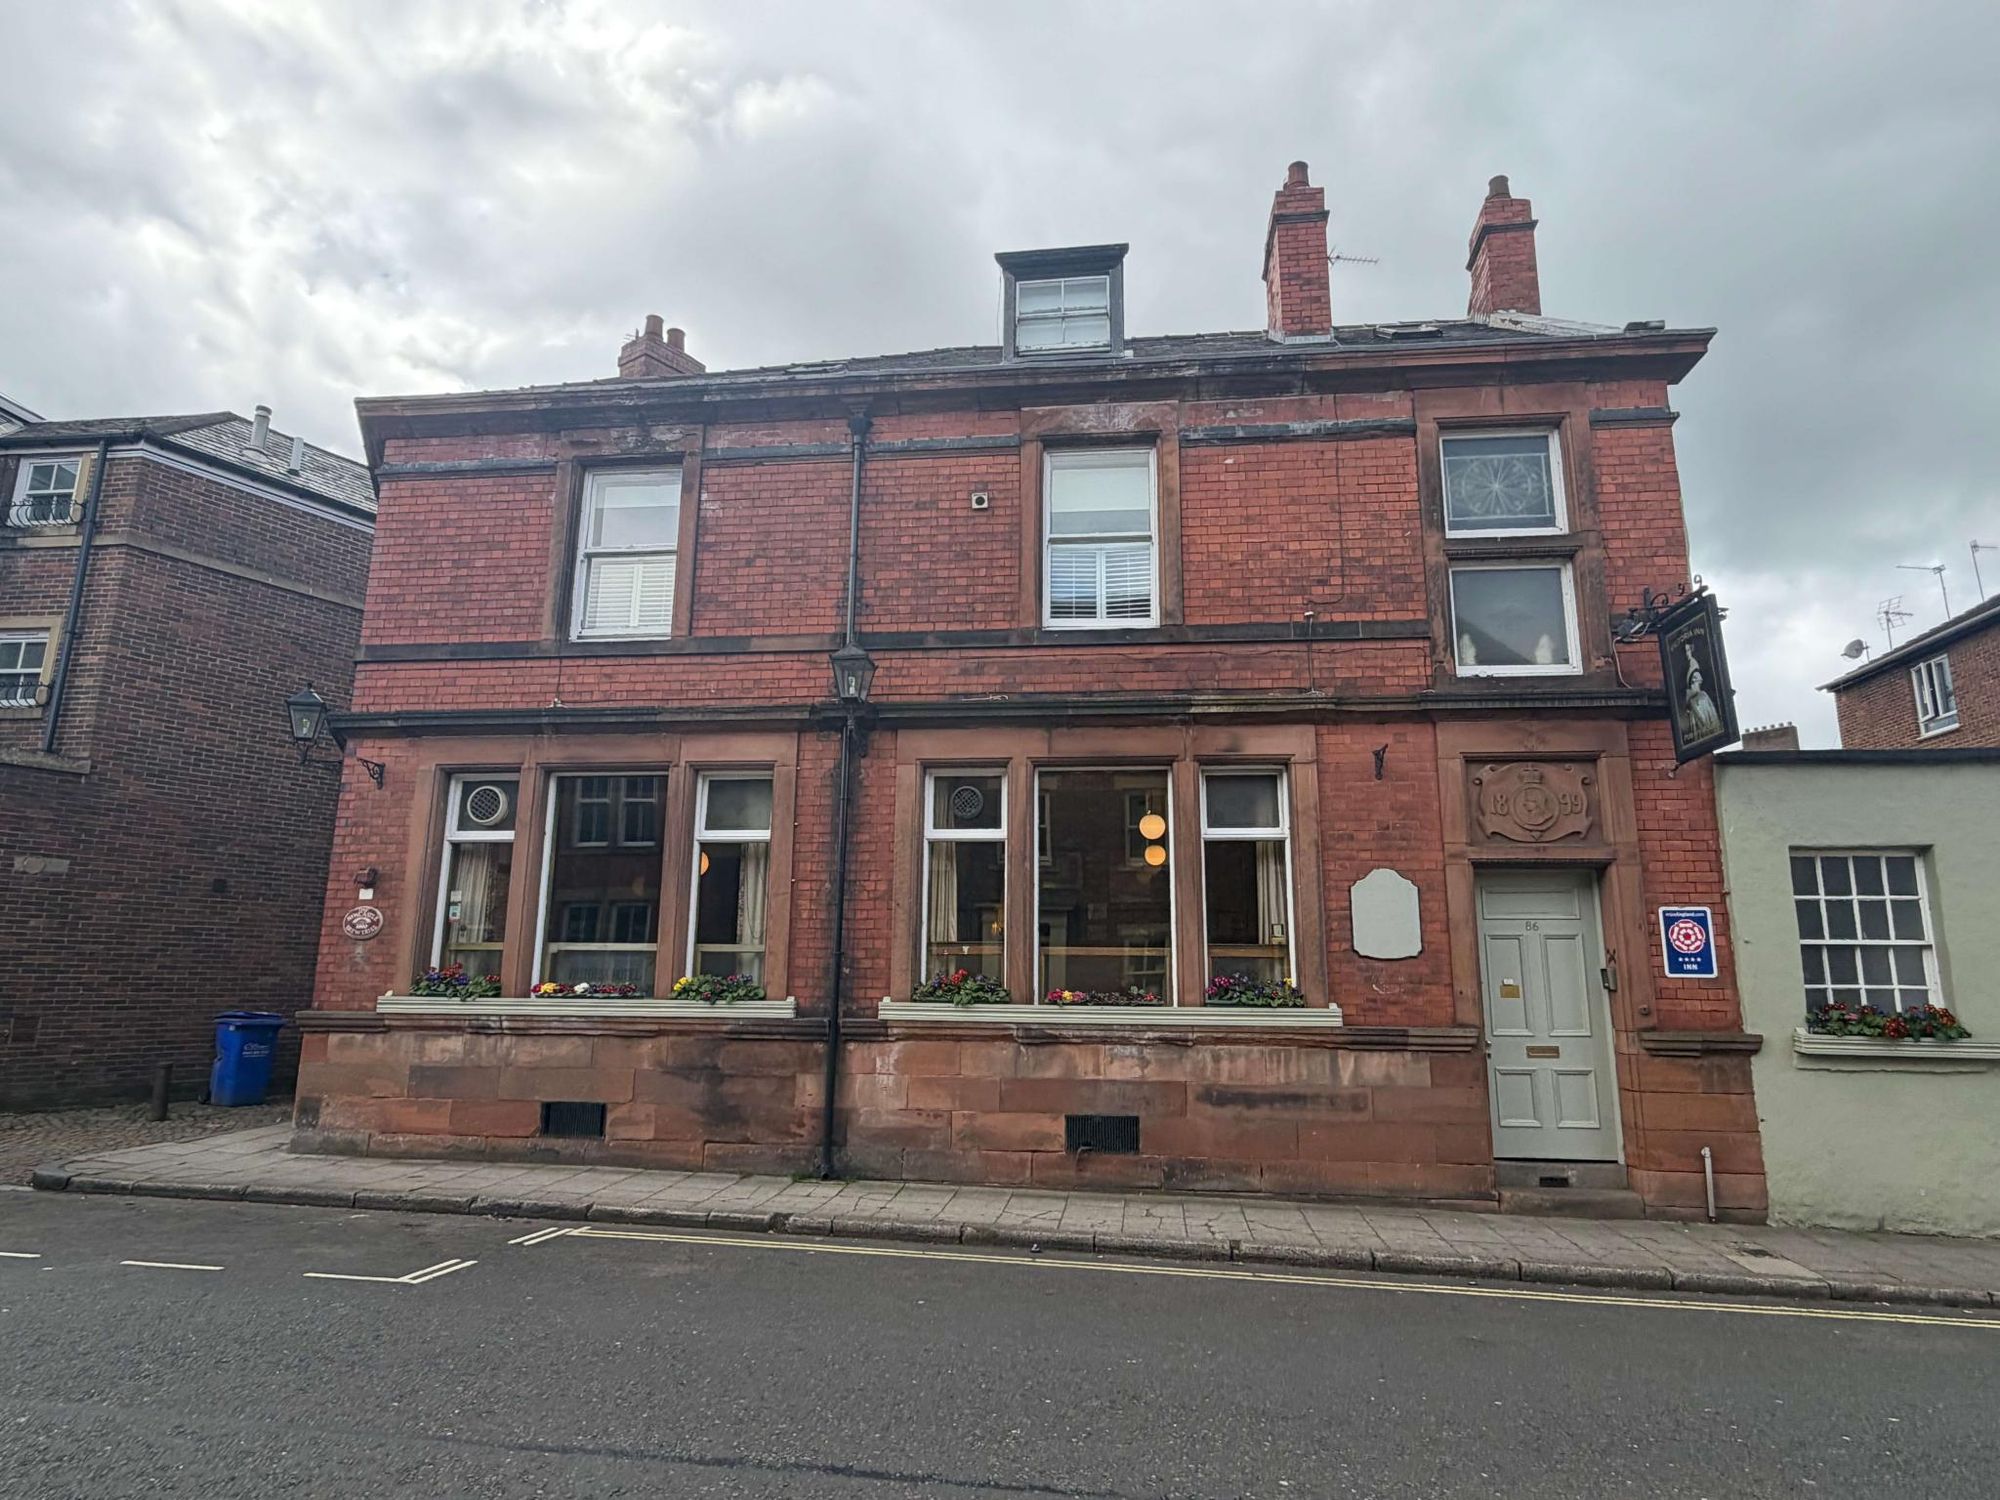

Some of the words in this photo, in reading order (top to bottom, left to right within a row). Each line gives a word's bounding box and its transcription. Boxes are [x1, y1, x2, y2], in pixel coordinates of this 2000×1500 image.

[1693, 627, 1705, 636] INN
[1490, 793, 1509, 816] 18
[1559, 793, 1584, 816] 99
[1525, 921, 1540, 932] 86
